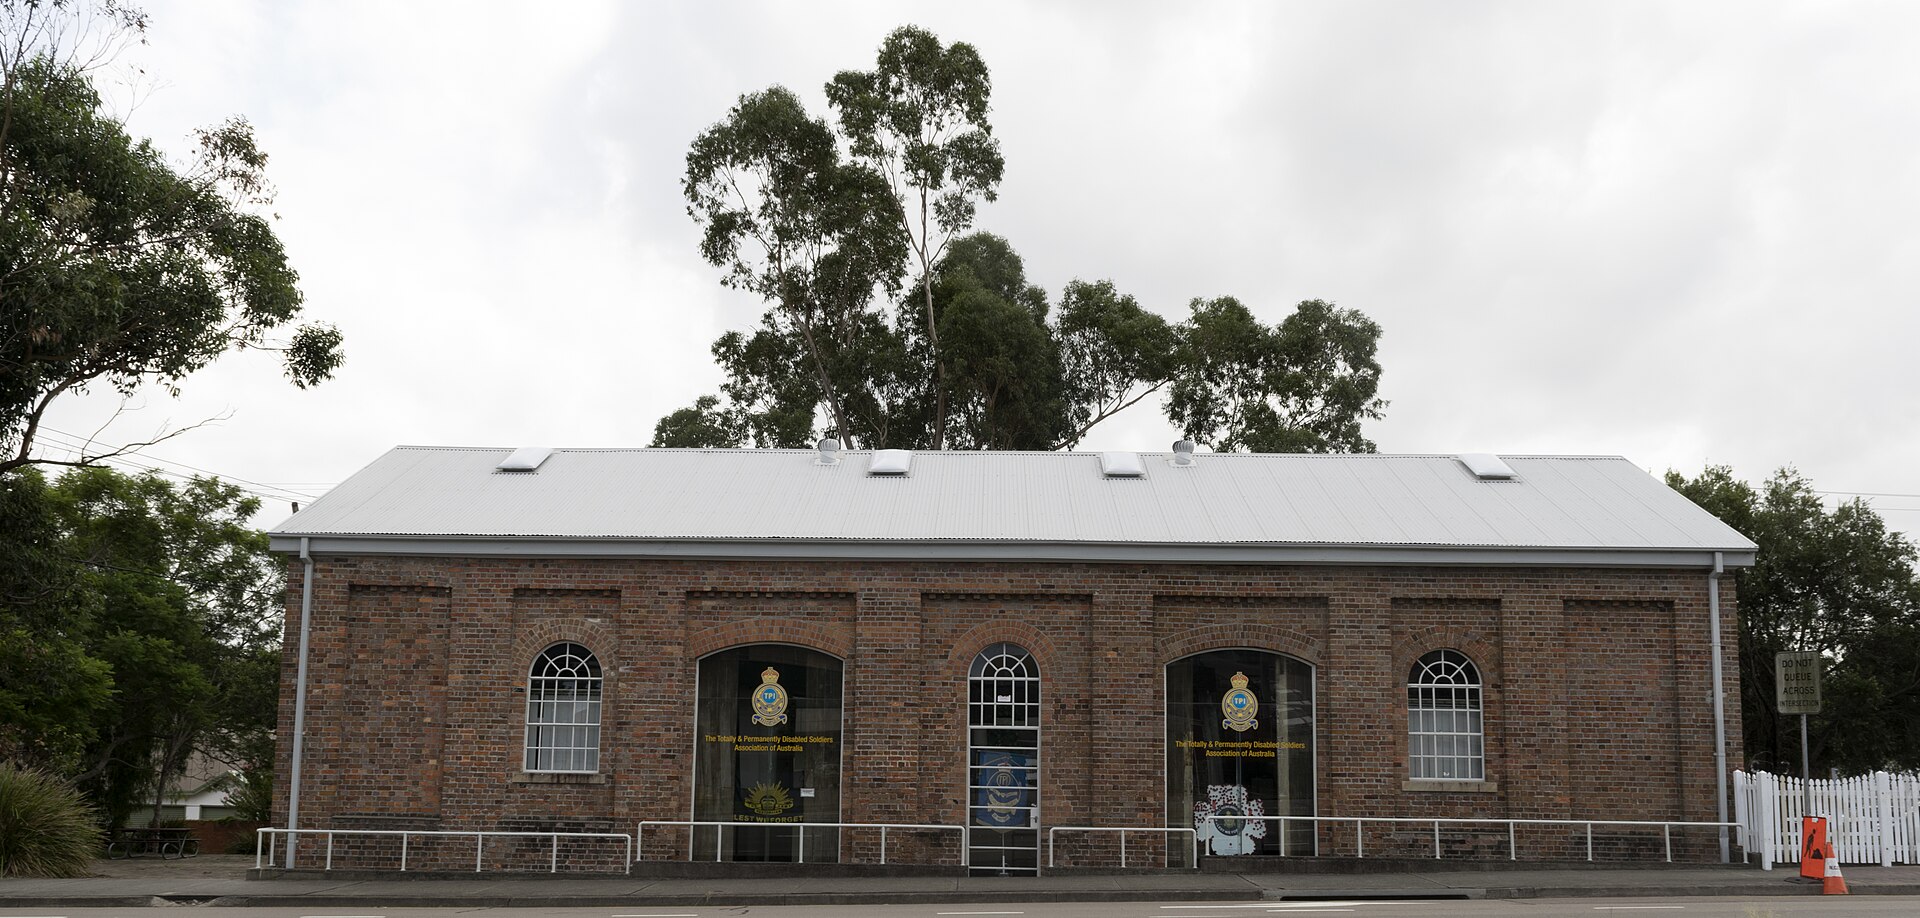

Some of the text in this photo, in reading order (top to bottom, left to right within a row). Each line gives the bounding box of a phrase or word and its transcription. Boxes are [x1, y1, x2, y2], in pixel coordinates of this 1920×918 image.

[1781, 659, 1813, 668] DO NOT
[1784, 672, 1812, 681] QUEUE
[1783, 686, 1815, 695] ACROSS
[764, 692, 776, 700] TPI
[717, 735, 736, 743] Totally
[744, 735, 781, 743] Permanently
[1214, 741, 1252, 749] Permanently
[733, 814, 754, 822] LEST
